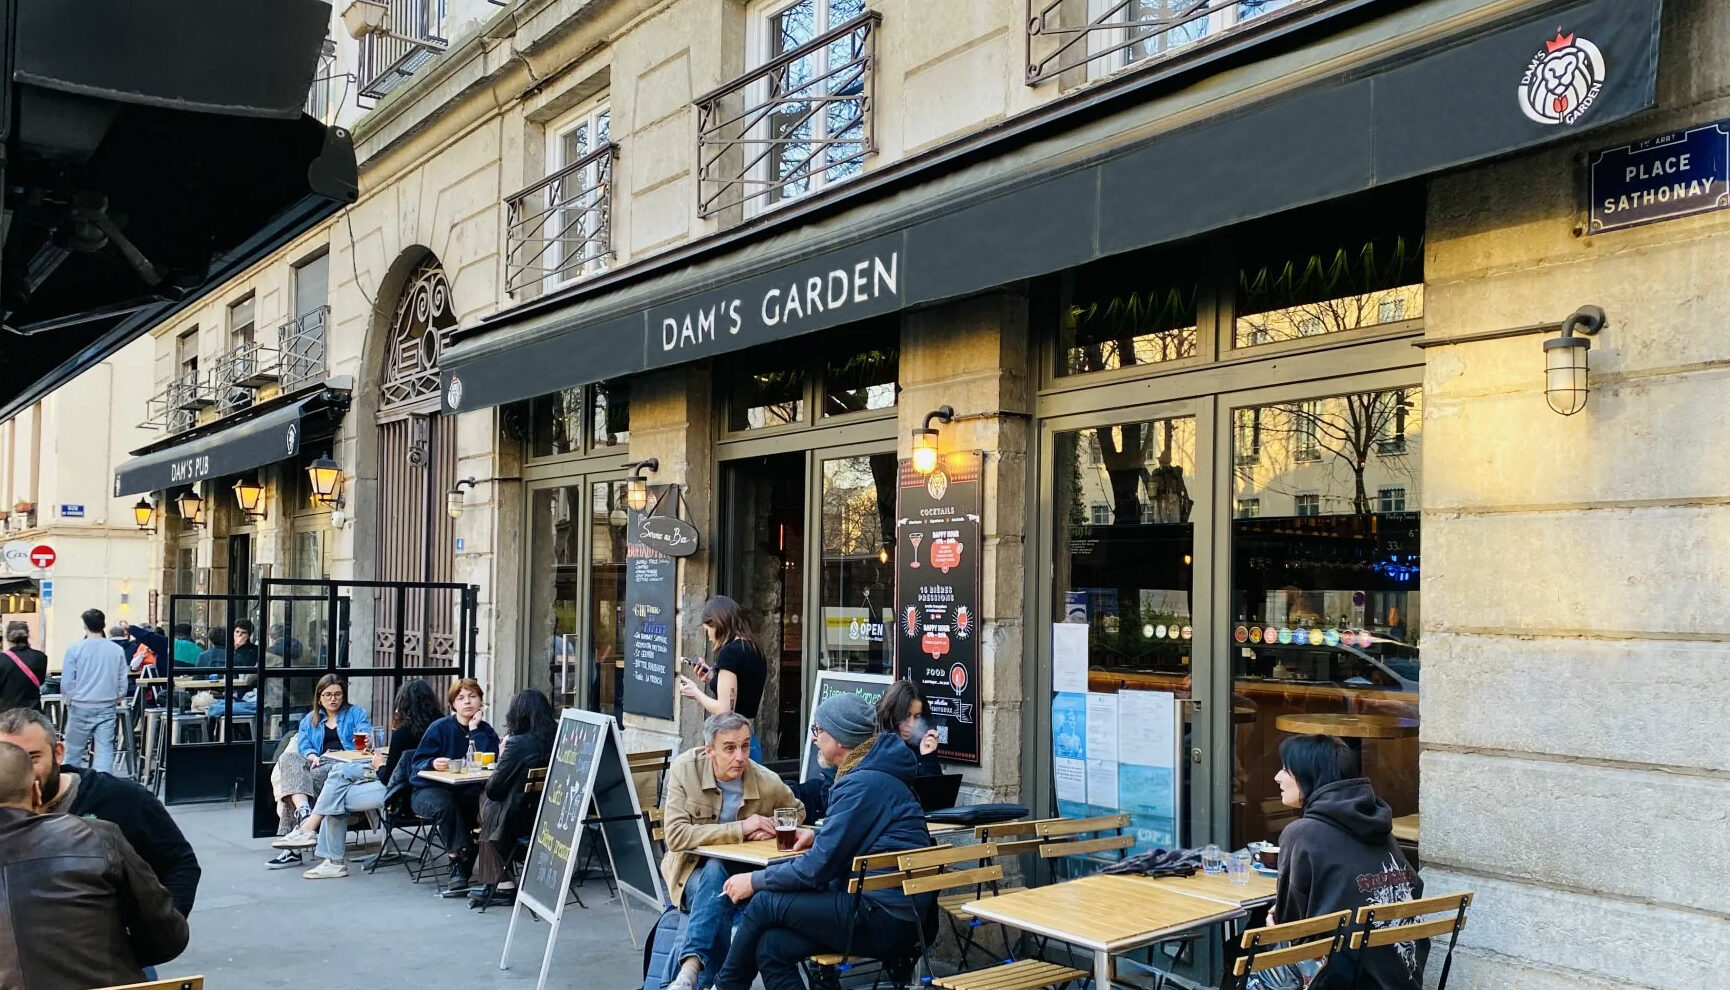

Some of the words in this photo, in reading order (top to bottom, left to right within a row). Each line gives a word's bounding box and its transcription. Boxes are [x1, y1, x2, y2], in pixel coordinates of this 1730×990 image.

[1521, 49, 1547, 87] DAM'S
[1565, 81, 1604, 126] GARDEN
[1625, 153, 1691, 182] PLACE
[1603, 176, 1715, 214] SATHONAY
[662, 299, 742, 351] DAM'S
[761, 252, 898, 326] GARDEN
[171, 460, 193, 482] DAM'S
[195, 455, 209, 478] PUB
[920, 507, 955, 516] COCKTAILS
[917, 593, 955, 602] PRESSIONS
[929, 584, 953, 594] BIÈRES
[860, 623, 883, 636] OPEN
[926, 667, 946, 677] FOOD
